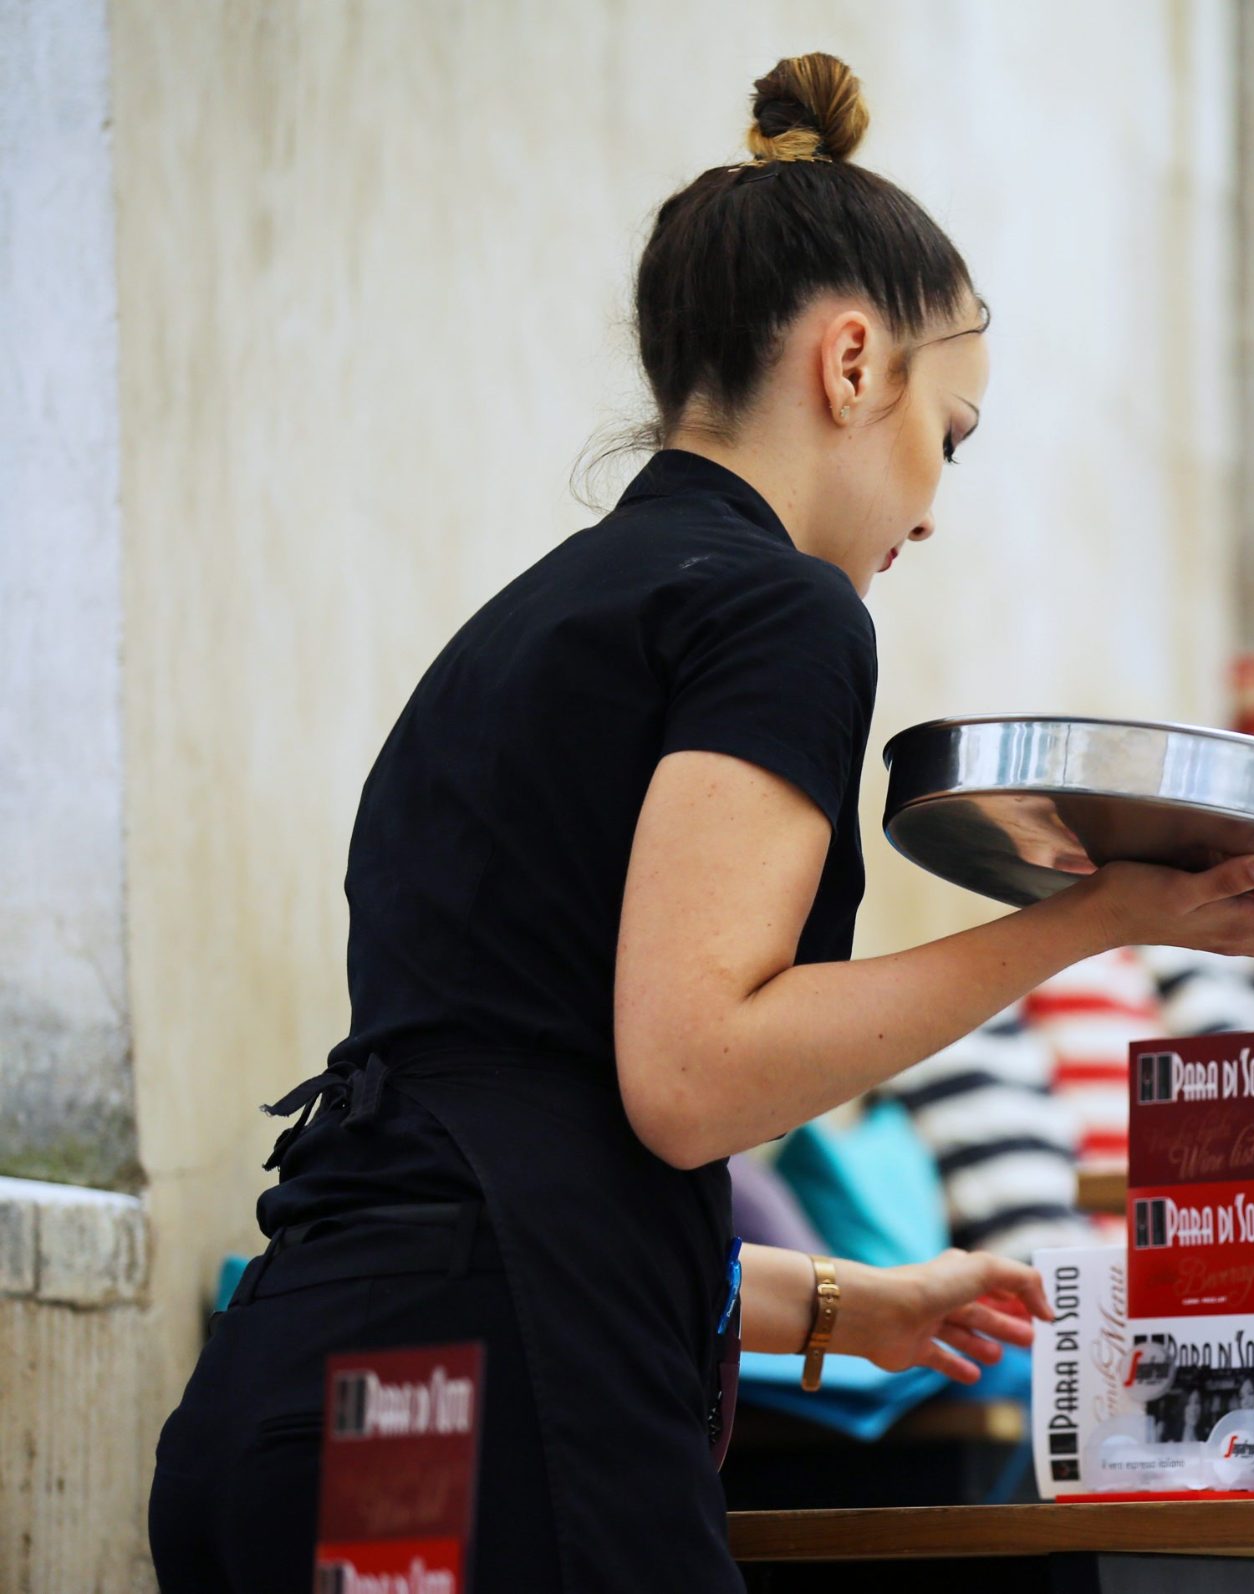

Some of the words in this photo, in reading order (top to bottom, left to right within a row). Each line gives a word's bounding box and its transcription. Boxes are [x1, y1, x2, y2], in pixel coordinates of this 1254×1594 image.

[1172, 1052, 1218, 1102] PARA
[1222, 1060, 1238, 1098] DI
[1166, 1197, 1214, 1247] PARA
[1217, 1205, 1234, 1244] DI
[1052, 1266, 1080, 1324] SOTO
[1056, 1331, 1080, 1352] DI
[1048, 1361, 1080, 1430] PARA
